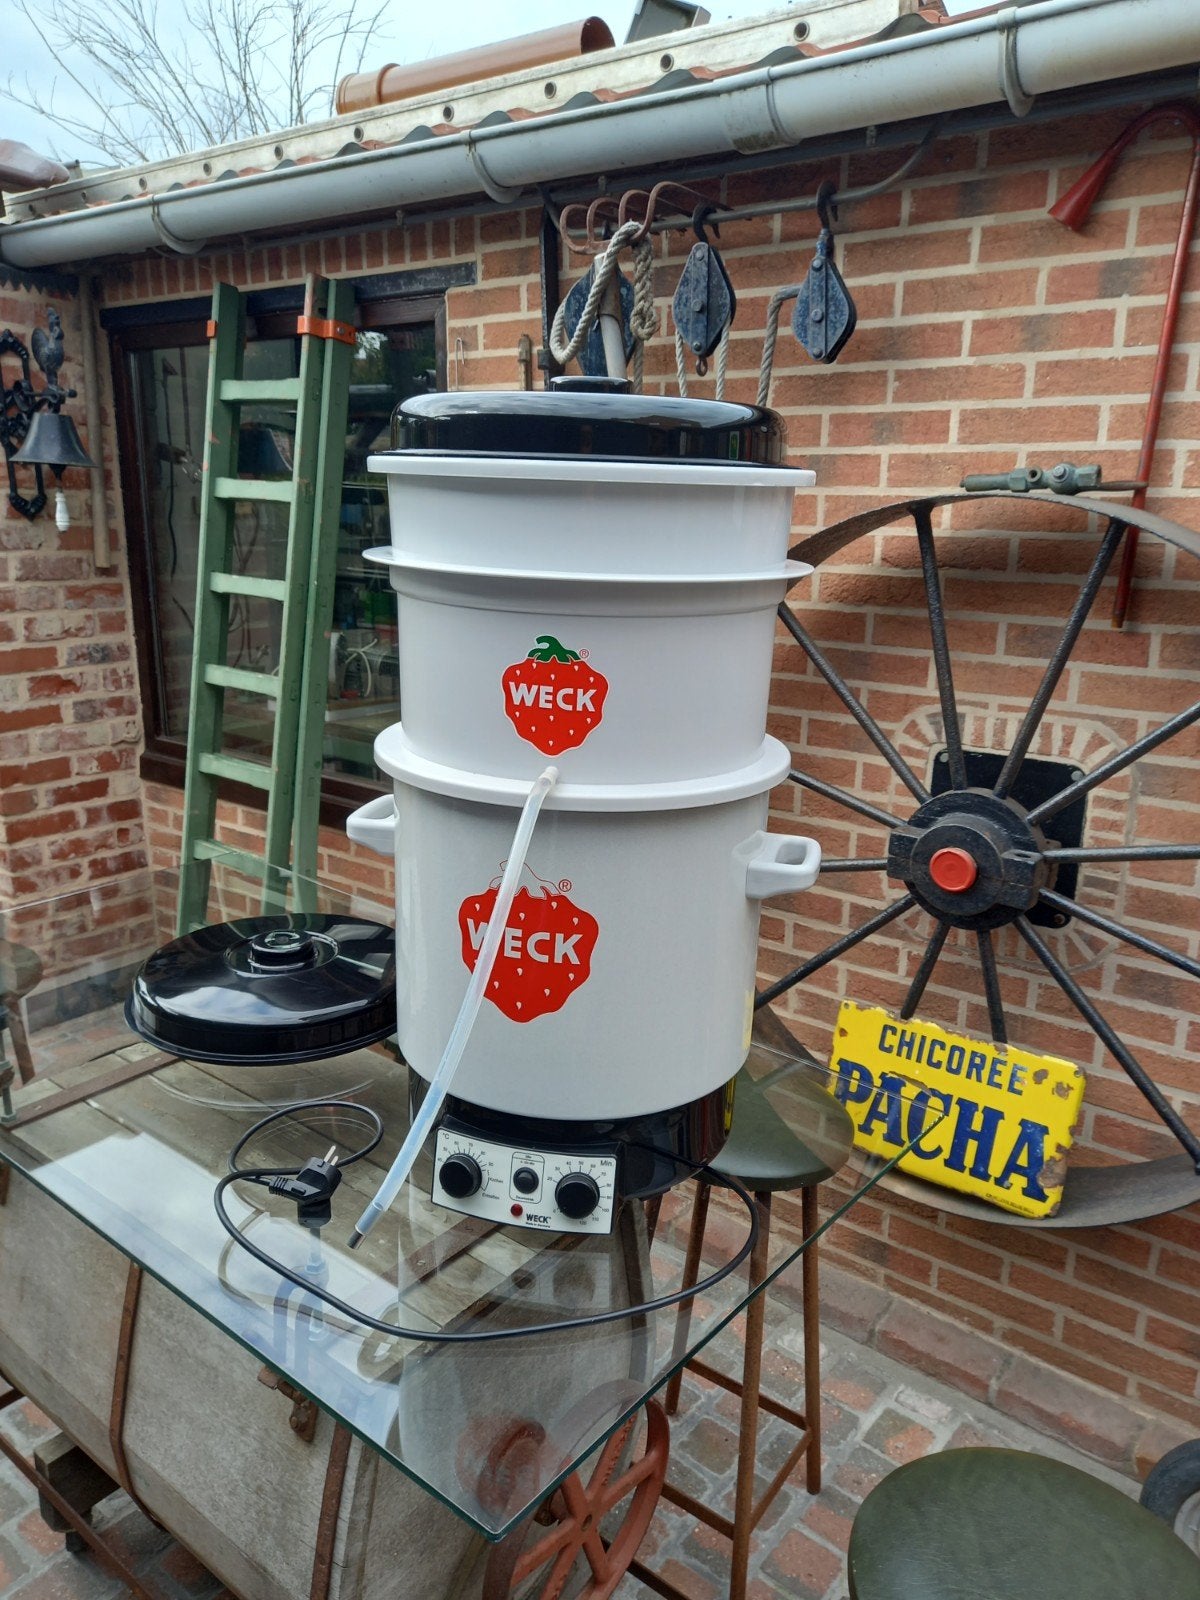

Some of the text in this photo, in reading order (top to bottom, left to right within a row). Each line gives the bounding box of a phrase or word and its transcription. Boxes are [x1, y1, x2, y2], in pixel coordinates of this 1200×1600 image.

[508, 681, 597, 712] WECK
[878, 1023, 1029, 1096] CHICOREE
[834, 1058, 1050, 1203] PACHA
[526, 1213, 549, 1224] WECK
